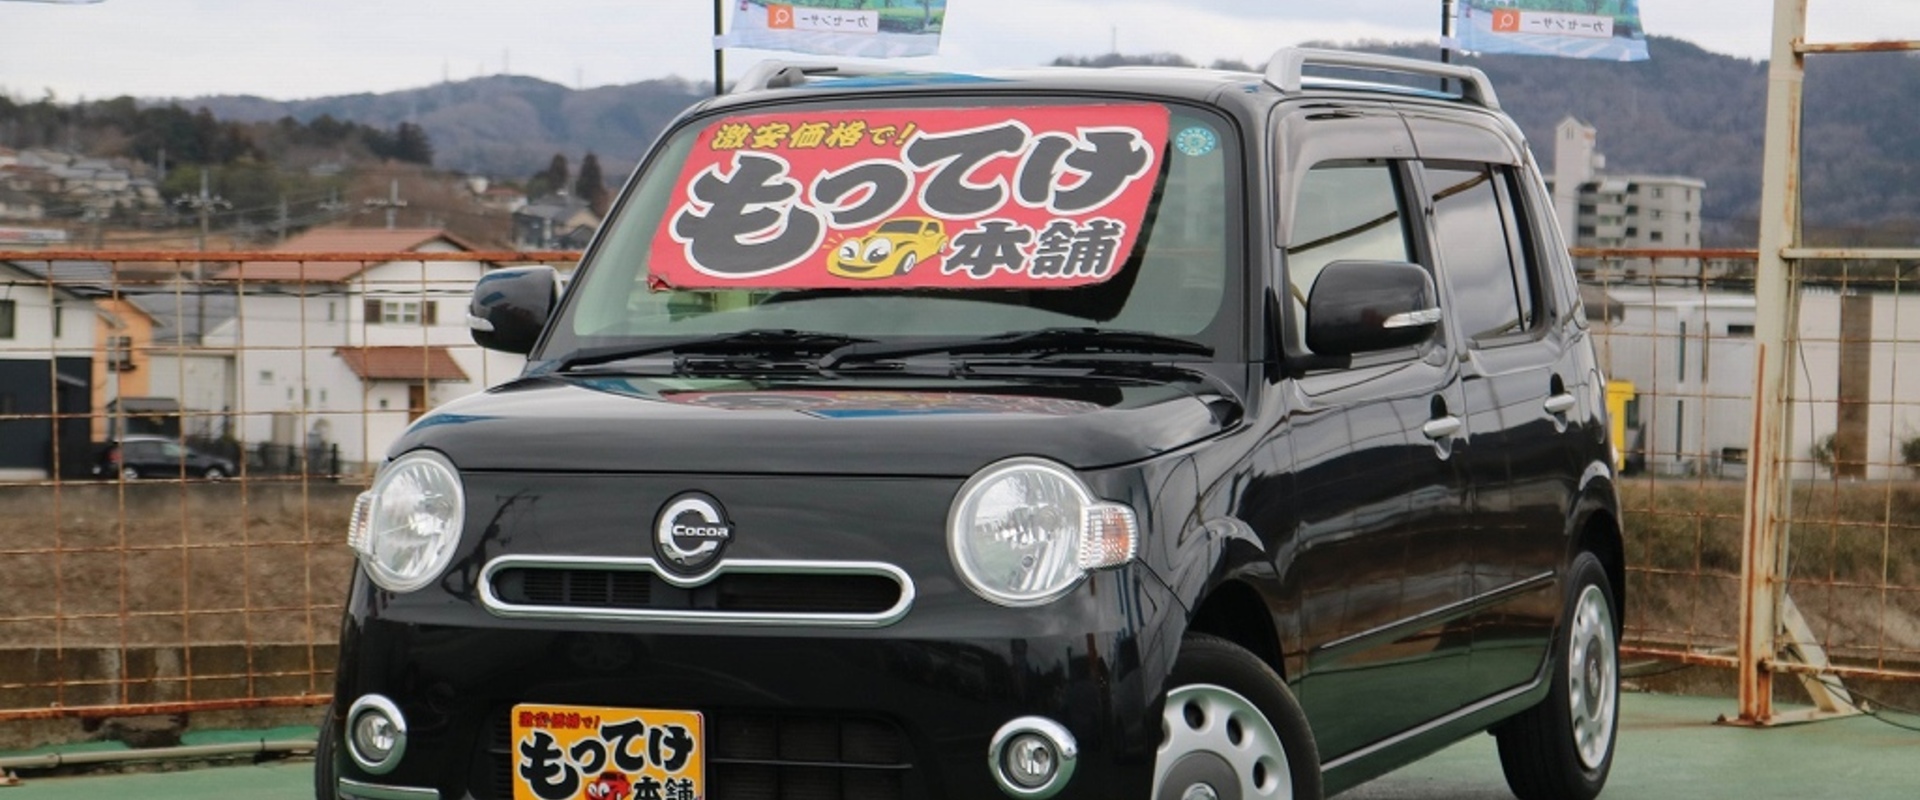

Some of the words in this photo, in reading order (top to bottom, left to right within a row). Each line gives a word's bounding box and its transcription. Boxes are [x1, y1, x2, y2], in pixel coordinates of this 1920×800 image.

[670, 119, 1155, 277] もってけ
[940, 220, 1127, 280] 本舗
[519, 719, 694, 800] もってけ
